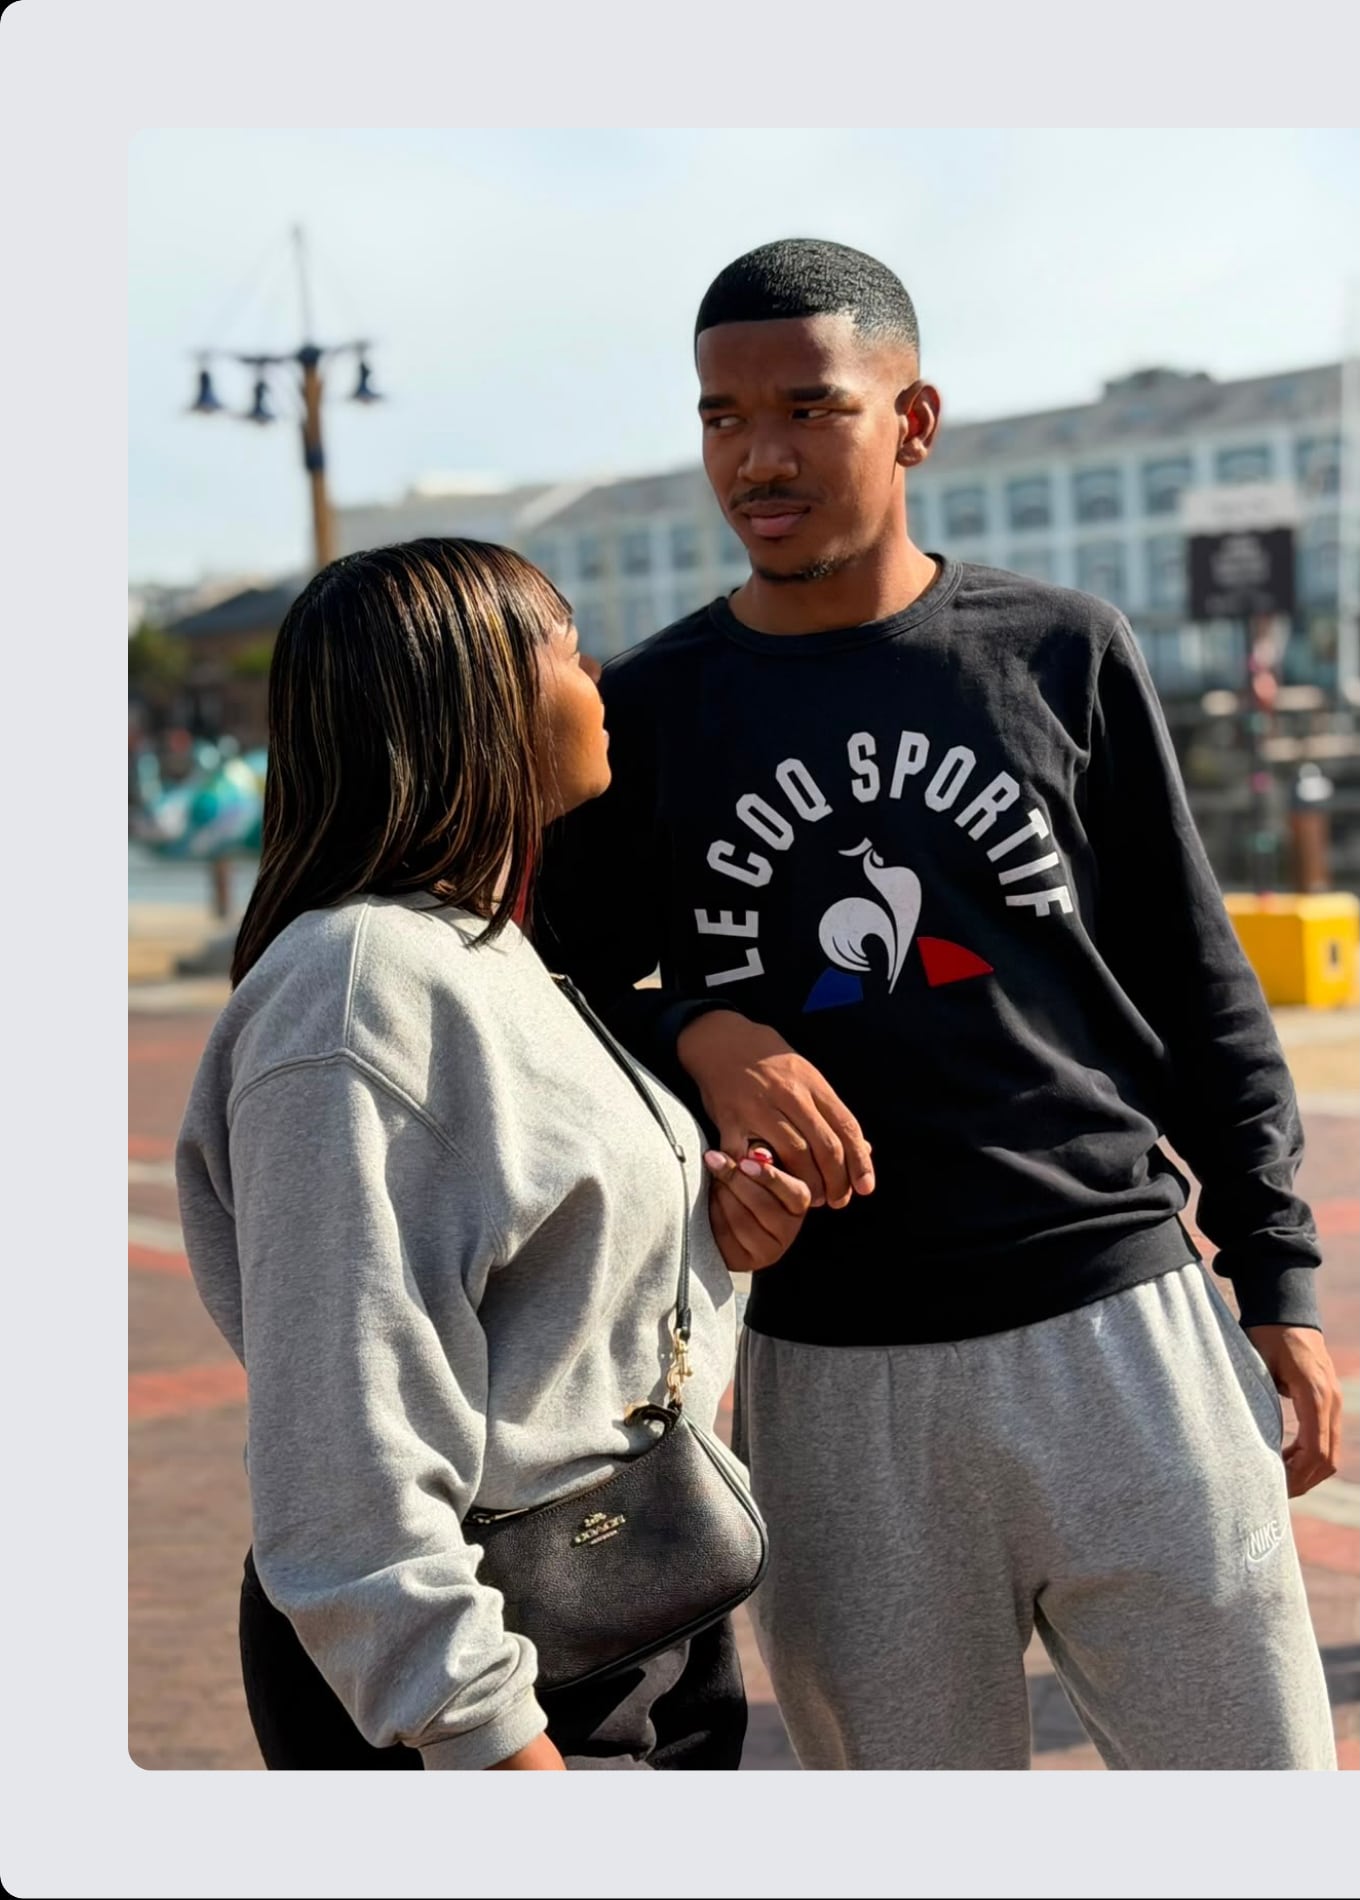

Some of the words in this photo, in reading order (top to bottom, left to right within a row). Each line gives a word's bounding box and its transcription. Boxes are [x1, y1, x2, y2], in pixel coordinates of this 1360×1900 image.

[706, 757, 833, 888] COQ
[846, 730, 1074, 918] SPORTIF
[694, 907, 765, 988] LE
[1249, 1520, 1281, 1557] NIKE
